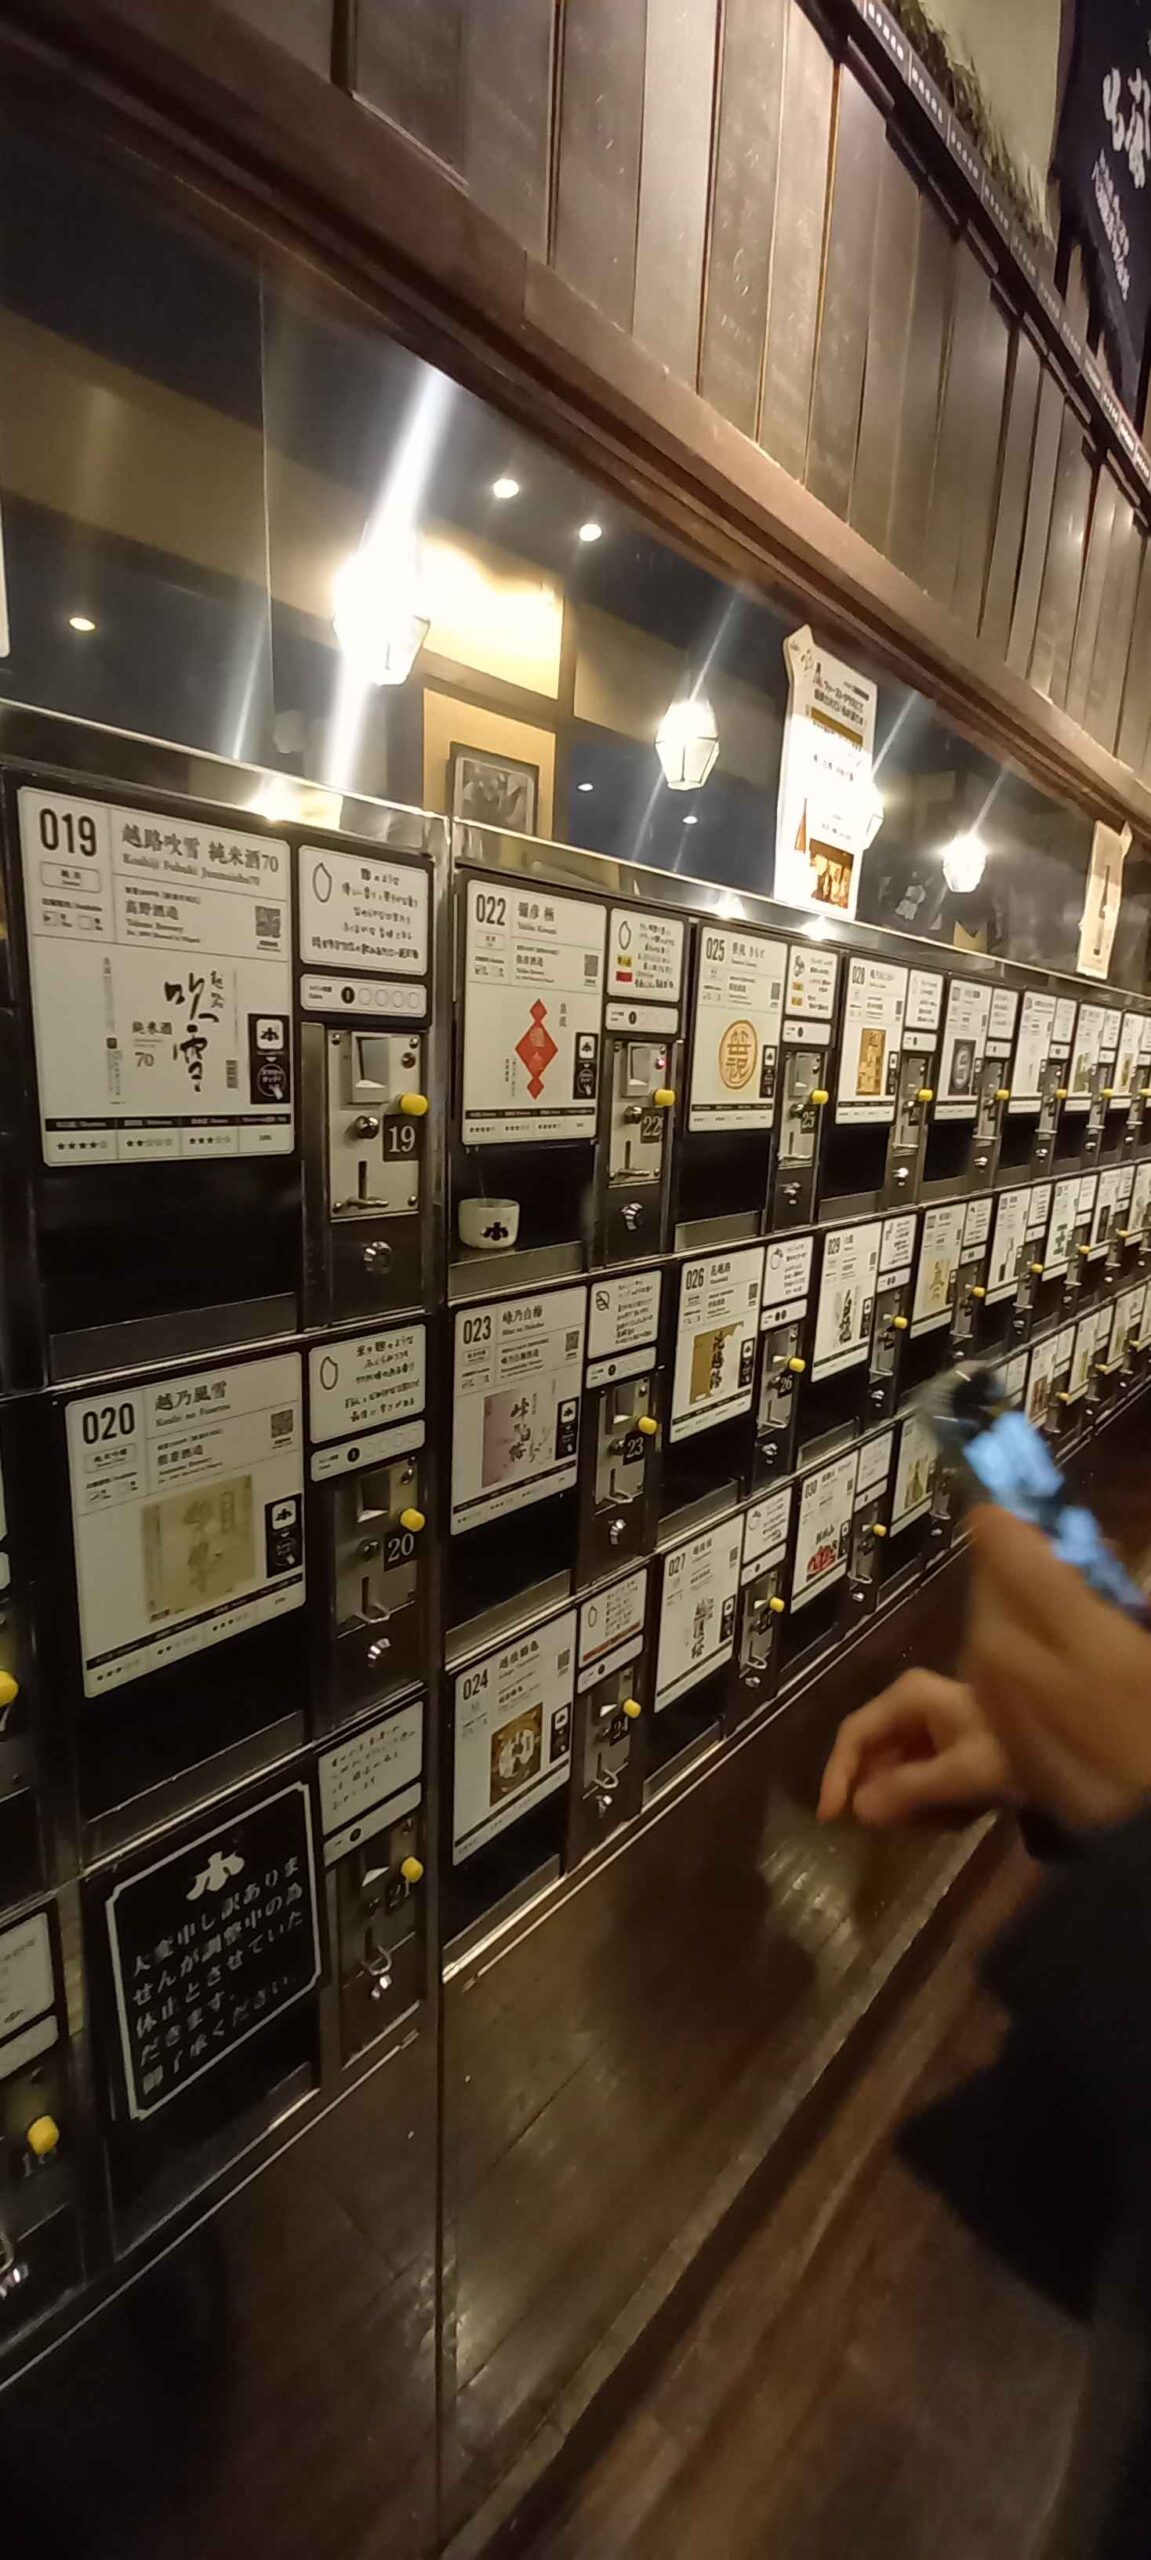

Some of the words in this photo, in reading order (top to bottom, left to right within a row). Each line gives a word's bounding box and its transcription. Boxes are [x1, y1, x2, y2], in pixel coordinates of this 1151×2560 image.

[39, 808, 97, 857] 019
[122, 823, 200, 859] 越路吹雪
[208, 841, 279, 873] 純米酒70
[476, 893, 506, 926] 022
[706, 937, 725, 962] 025
[134, 1051, 155, 1068] 70
[642, 1115, 663, 1138] 22
[801, 1111, 816, 1129] 25
[388, 1124, 416, 1152] 19
[685, 1267, 705, 1290] 026
[463, 1315, 492, 1345] 023
[779, 1376, 793, 1394] 26
[82, 1403, 135, 1445] 020
[626, 1436, 645, 1460] 23
[387, 1532, 415, 1563] 20
[668, 1553, 687, 1577] 027
[462, 1669, 489, 1701] 024
